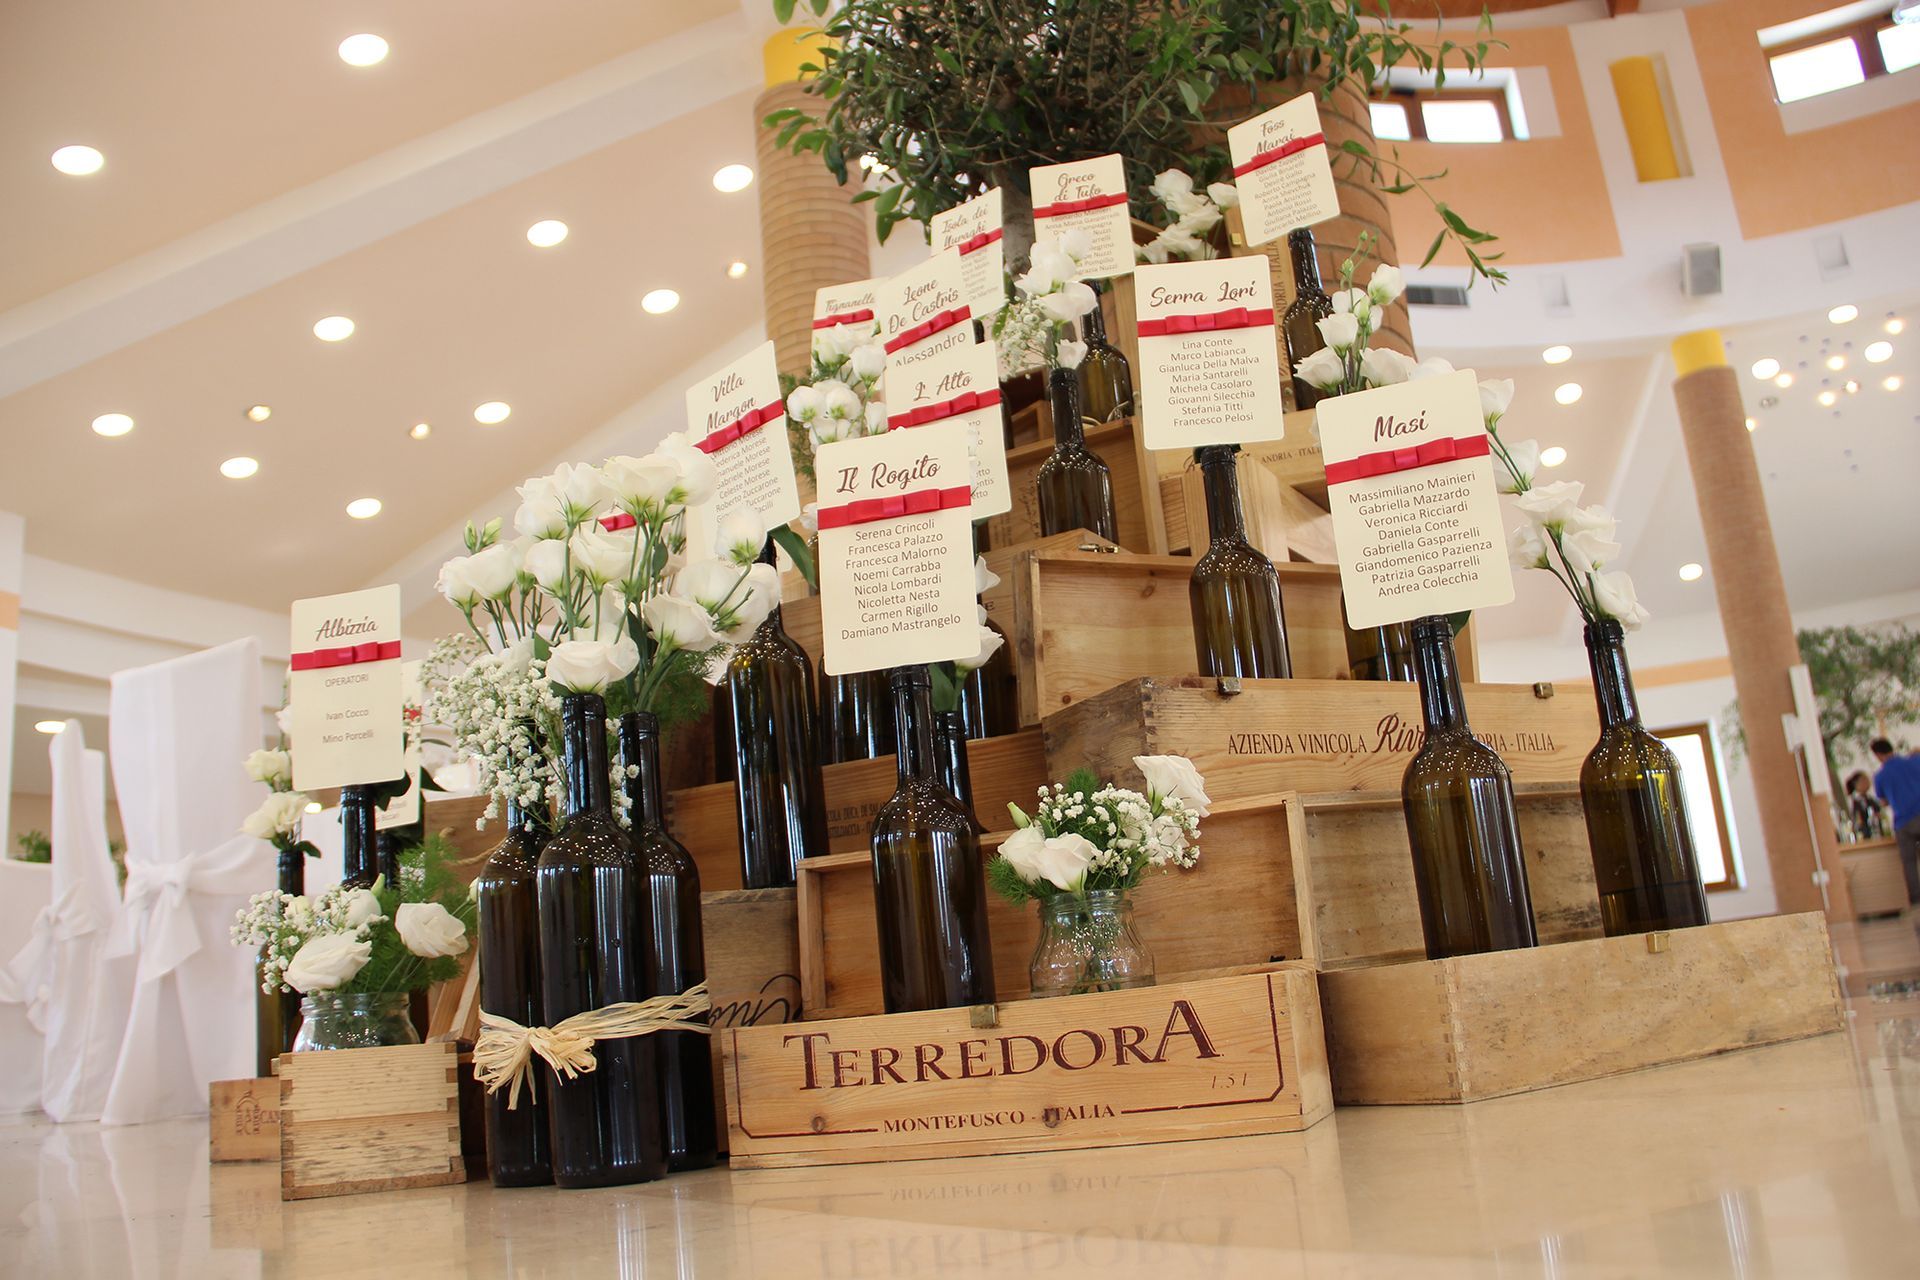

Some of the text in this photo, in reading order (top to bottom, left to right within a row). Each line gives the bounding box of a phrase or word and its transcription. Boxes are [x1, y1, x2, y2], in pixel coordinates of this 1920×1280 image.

[1054, 188, 1069, 201] di
[1150, 280, 1258, 307] Serra Lori
[1171, 347, 1246, 361] Marco Labianca
[1182, 338, 1233, 350] Lina Conte
[1159, 356, 1260, 373] Gianluca Della Malva
[1172, 368, 1248, 383] Maria Santarelli
[712, 372, 745, 403] Villa
[936, 371, 973, 396] Alto
[1170, 379, 1252, 394] Michela Casolaro
[1168, 389, 1255, 405] Giovanni Silecchia
[706, 396, 756, 435] Margon
[1174, 412, 1254, 427] Francesco Pelosi
[1182, 403, 1243, 415] Stefania Titti
[1374, 410, 1430, 443] Masi
[716, 437, 767, 468] ederica Morese
[745, 446, 771, 466] Morese
[1261, 452, 1293, 464] ANDRIA
[744, 458, 770, 477] Morese
[871, 455, 940, 490] Rogito
[744, 470, 770, 488] Morese
[1349, 471, 1476, 504] Massimiliano Mainieri
[1359, 487, 1470, 517] Gabriella Mazzardo
[1364, 501, 1469, 529] Veronica Ricciardi
[855, 519, 935, 541] Serena Crincoli
[1379, 518, 1459, 541] Daniela Conte
[848, 533, 944, 556] Francesca Palazzo
[1362, 527, 1480, 557] Gabriella Gasparrelli
[846, 546, 948, 569] Francesca Malorno
[1355, 540, 1492, 573] Giandomenico Pazienza
[853, 560, 941, 582] Noemi Carrabba
[1372, 555, 1480, 584] Patrizia Gasparrelli
[854, 574, 942, 596] Nicola Lombardi
[1378, 571, 1479, 598] Andrea Colecchia
[858, 589, 940, 609] Nicoletta Nesta
[861, 602, 939, 623] Carmen Rigillo
[316, 616, 378, 642] Albizzia
[842, 614, 961, 640] Damiano Mastrangelo
[325, 673, 369, 687] OPERATORI
[345, 709, 369, 718] Cocco
[1228, 733, 1294, 755] AZIENDA
[1298, 734, 1367, 753] VINICOLA
[1514, 733, 1555, 751] ITALIA
[783, 999, 1225, 1092] TERREDORA
[884, 1103, 1116, 1134] MONTEFUSCO ITALIA
